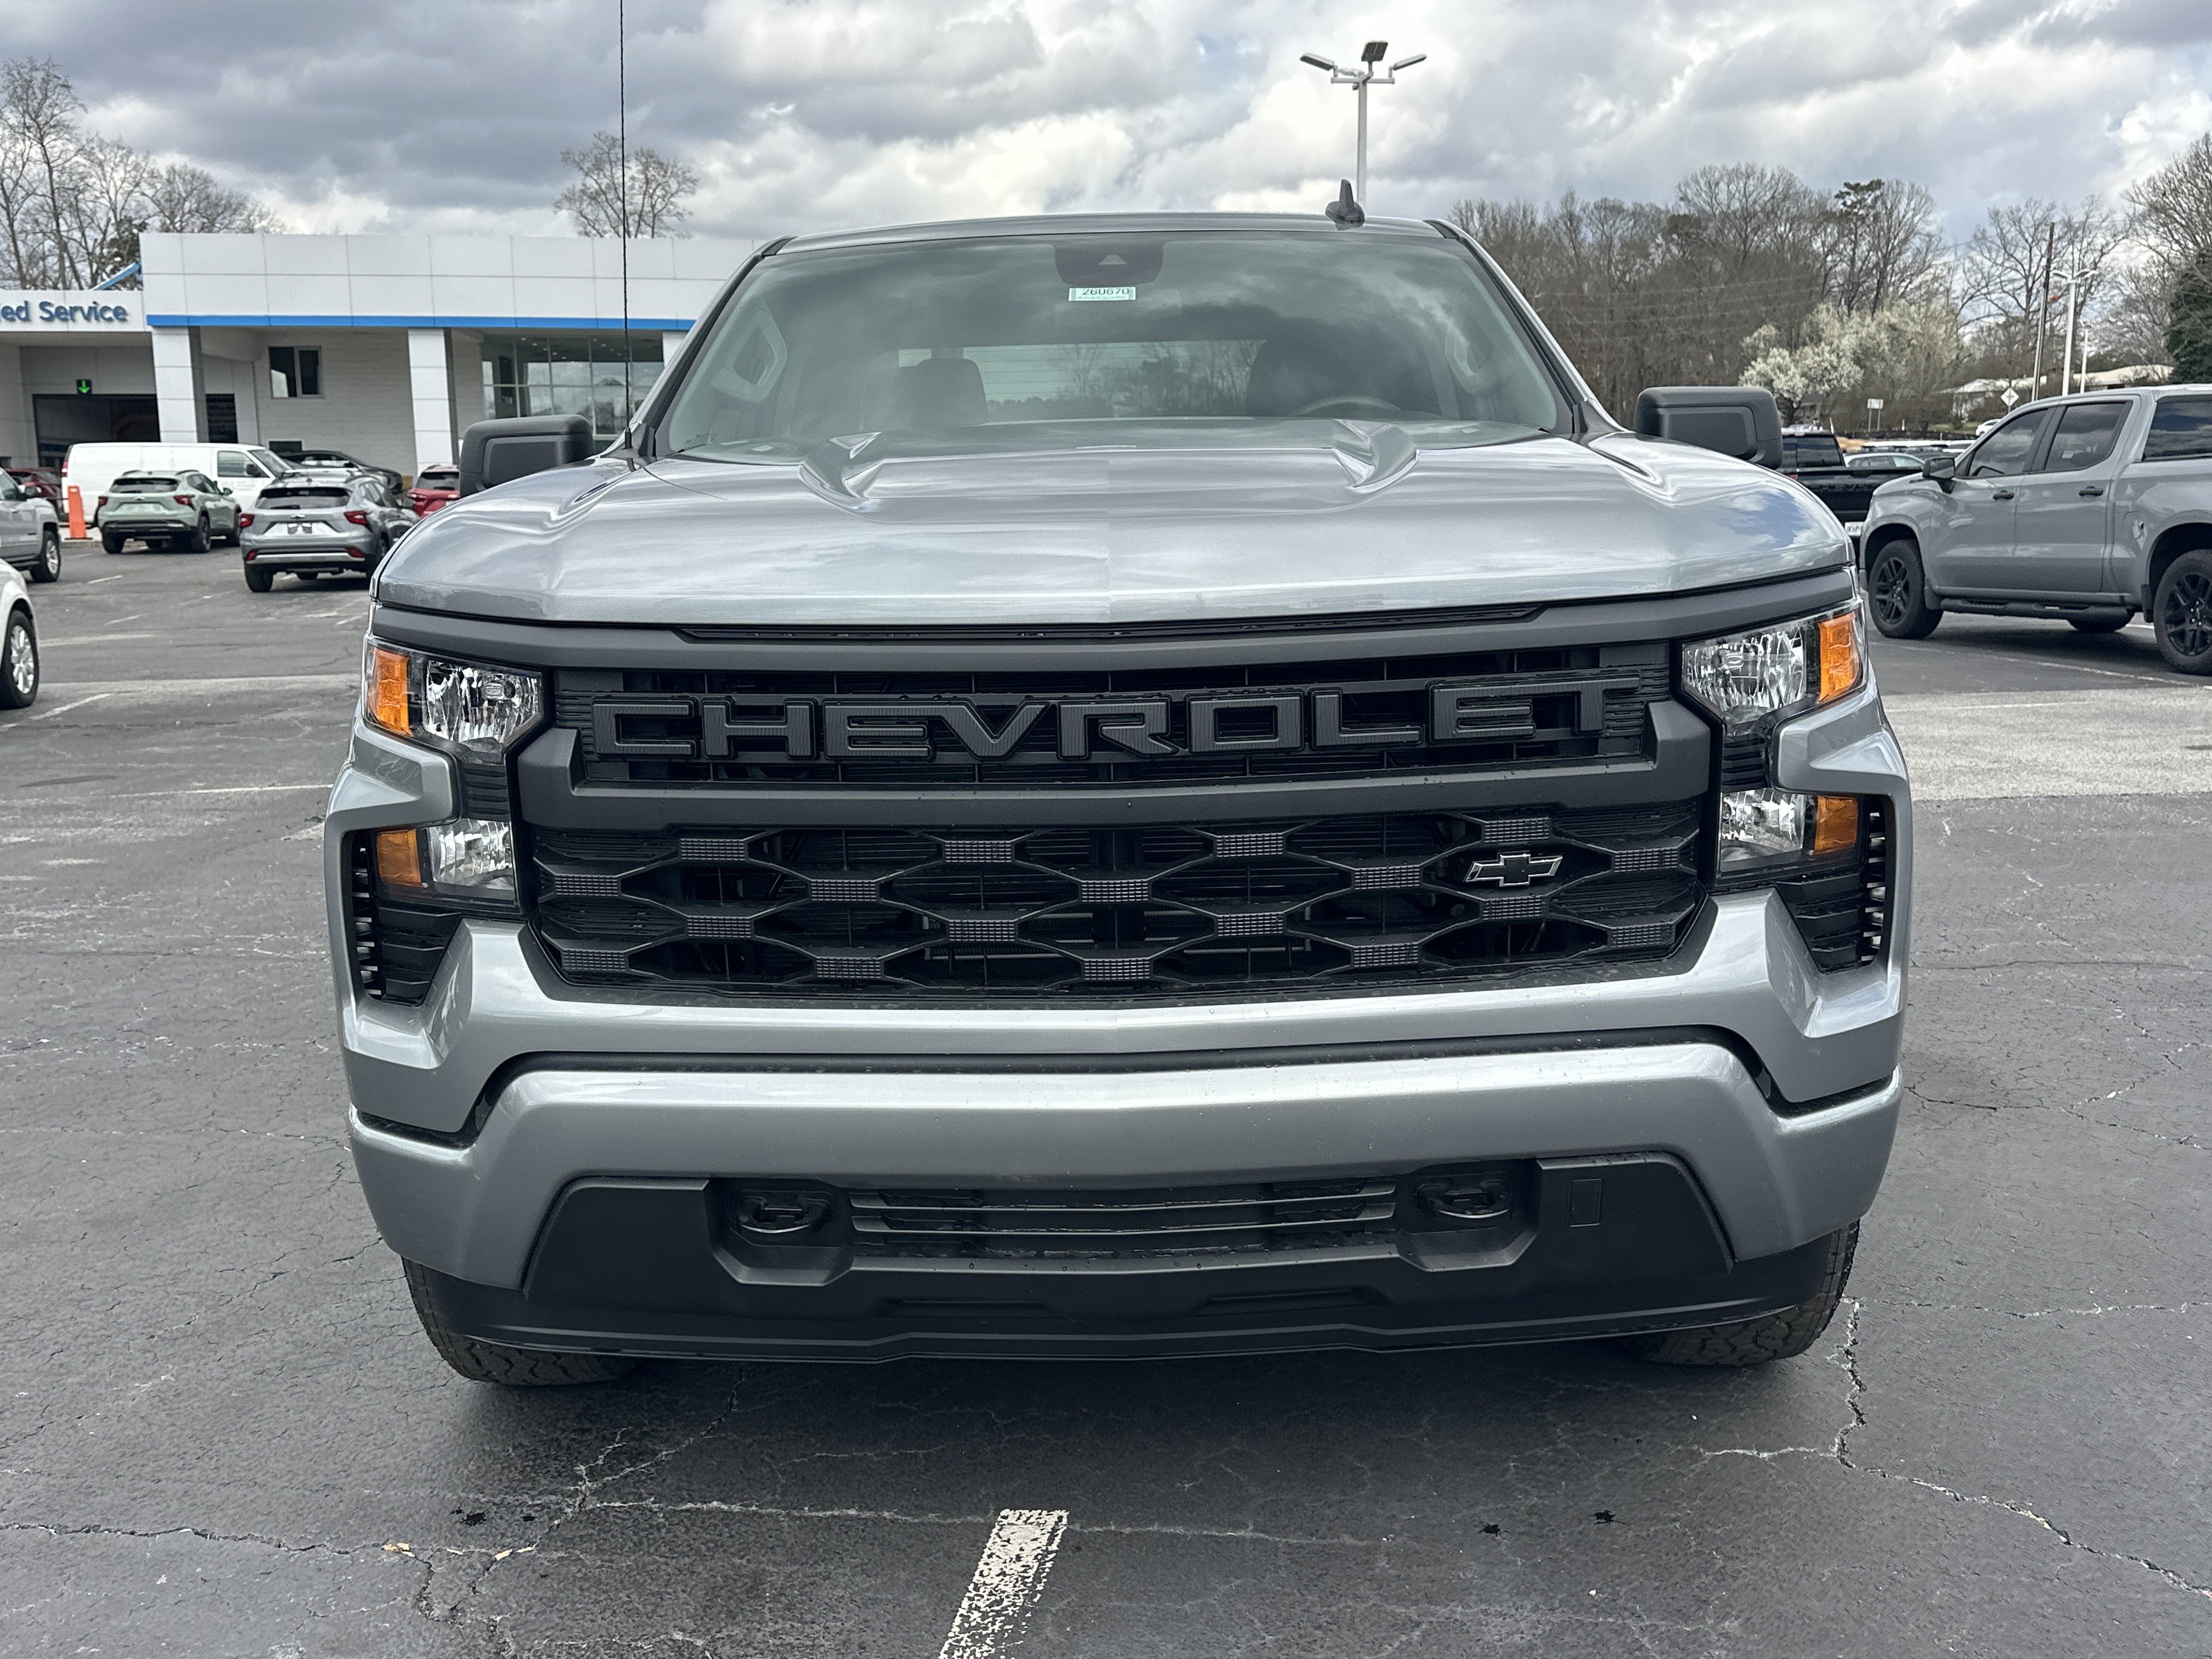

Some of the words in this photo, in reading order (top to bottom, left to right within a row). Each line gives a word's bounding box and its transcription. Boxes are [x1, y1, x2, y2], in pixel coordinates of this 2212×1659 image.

[0, 300, 30, 321] ed
[39, 301, 128, 322] Service
[591, 674, 1641, 760] CHEVROLET
